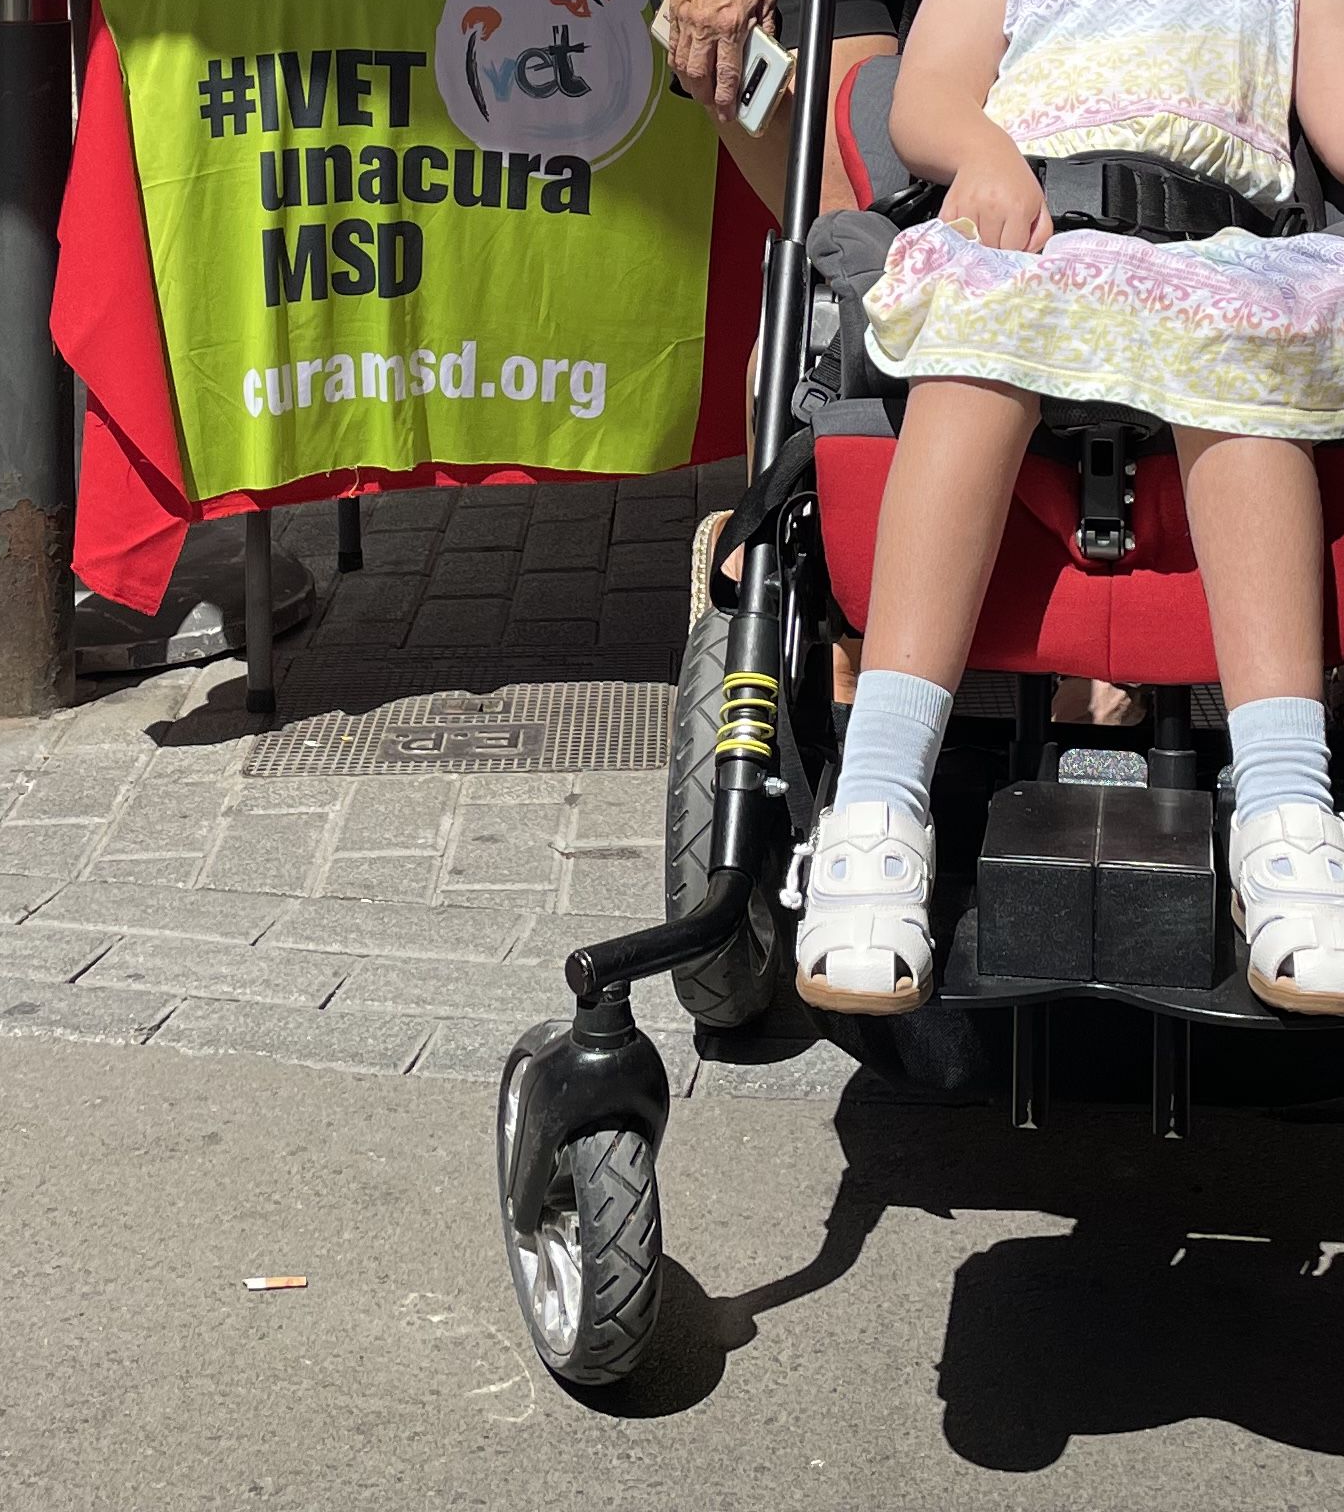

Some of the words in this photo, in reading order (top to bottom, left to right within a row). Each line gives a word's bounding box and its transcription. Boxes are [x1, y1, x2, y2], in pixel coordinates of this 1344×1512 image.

[197, 48, 427, 139] #IVET
[259, 142, 593, 216] unacura
[260, 217, 425, 308] MSD
[244, 340, 607, 419] curamsd.org
